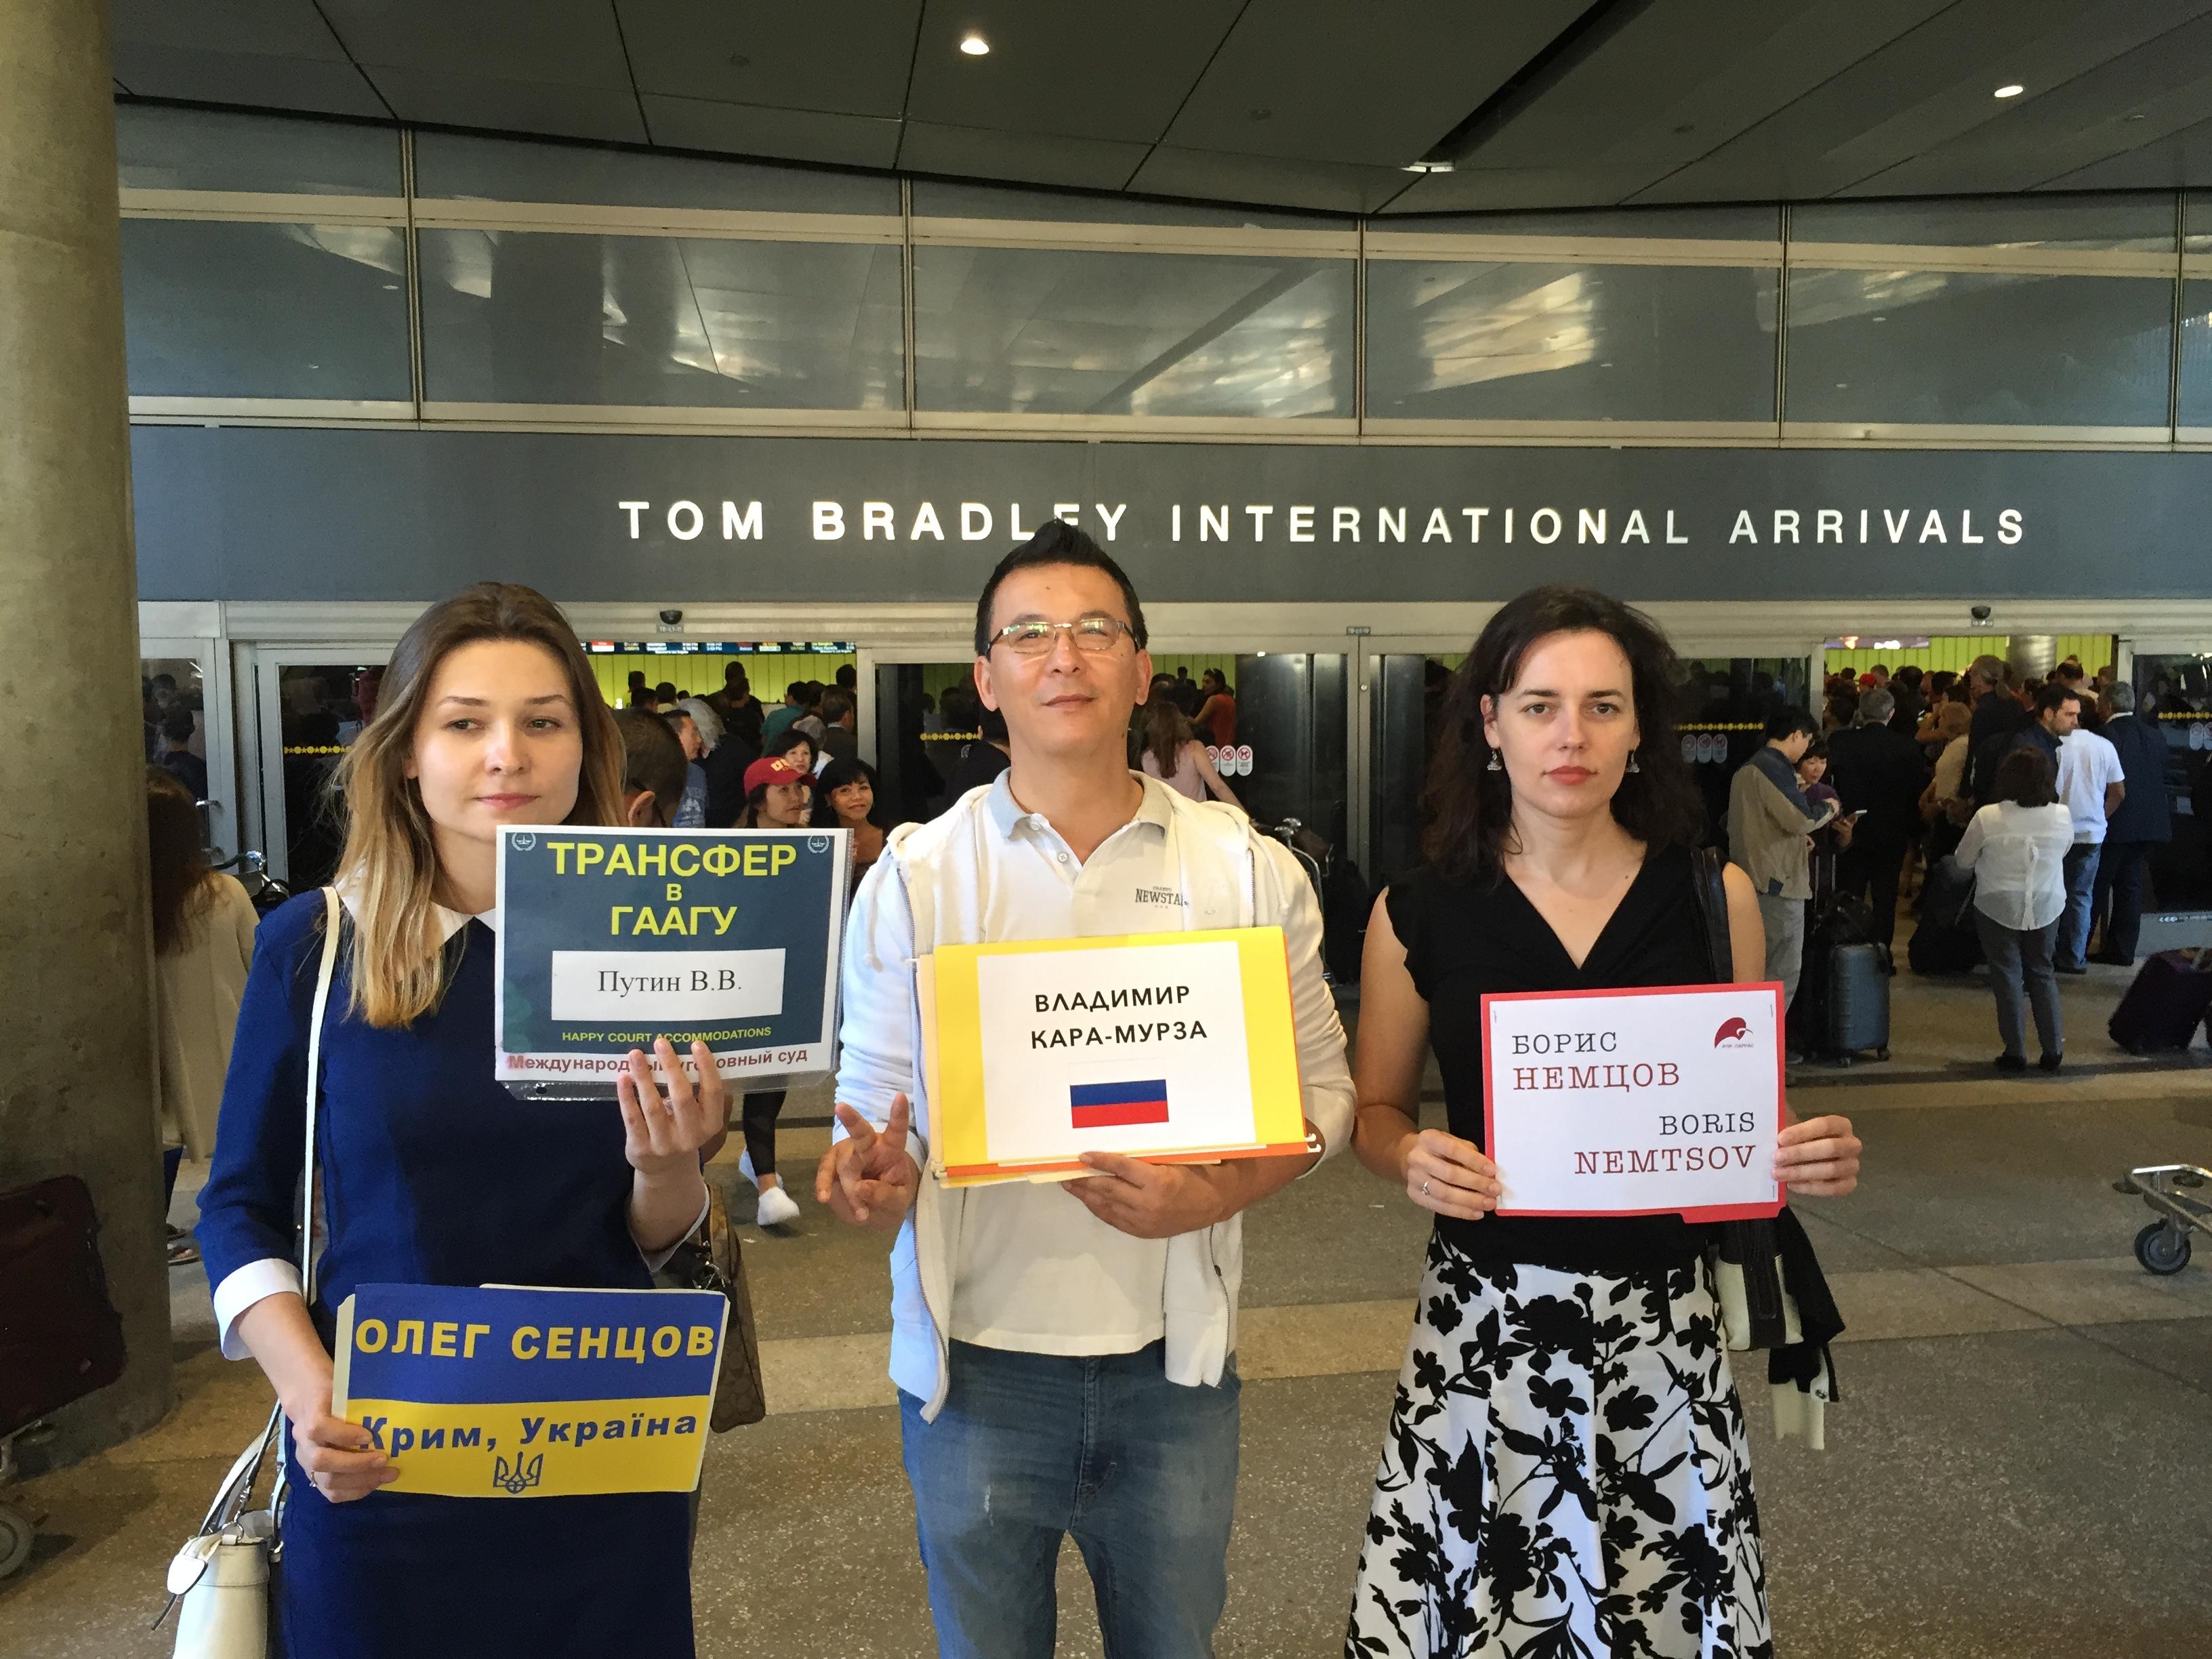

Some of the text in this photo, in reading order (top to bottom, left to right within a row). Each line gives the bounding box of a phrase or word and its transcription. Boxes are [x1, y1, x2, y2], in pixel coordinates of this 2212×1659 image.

[618, 500, 764, 541] TOM
[1172, 504, 1689, 545] INTERNATIONAL
[1729, 508, 2024, 546] ARRIVALS
[547, 842, 797, 877] ТРАНСФЕР
[666, 883, 682, 901] В
[611, 906, 738, 936] ГААГУ
[598, 968, 742, 998] Путин В.В.
[1034, 985, 1191, 1012] ВЛАДИМИР
[562, 1026, 772, 1043] HAPPY COURT ACCOMMODATIONS
[1031, 1019, 1208, 1049] КАРА-МУРЗА
[1511, 1031, 1618, 1055] БОРИС
[778, 1048, 808, 1065] суд
[1513, 1062, 1680, 1092] НЕМЦОВ
[1658, 1111, 1755, 1136] BORIS
[1574, 1144, 1757, 1174] NEMTSOV
[355, 1318, 715, 1364] ОЛЕГ СЕНЦОВ
[360, 1412, 697, 1458] Крим, Україна
